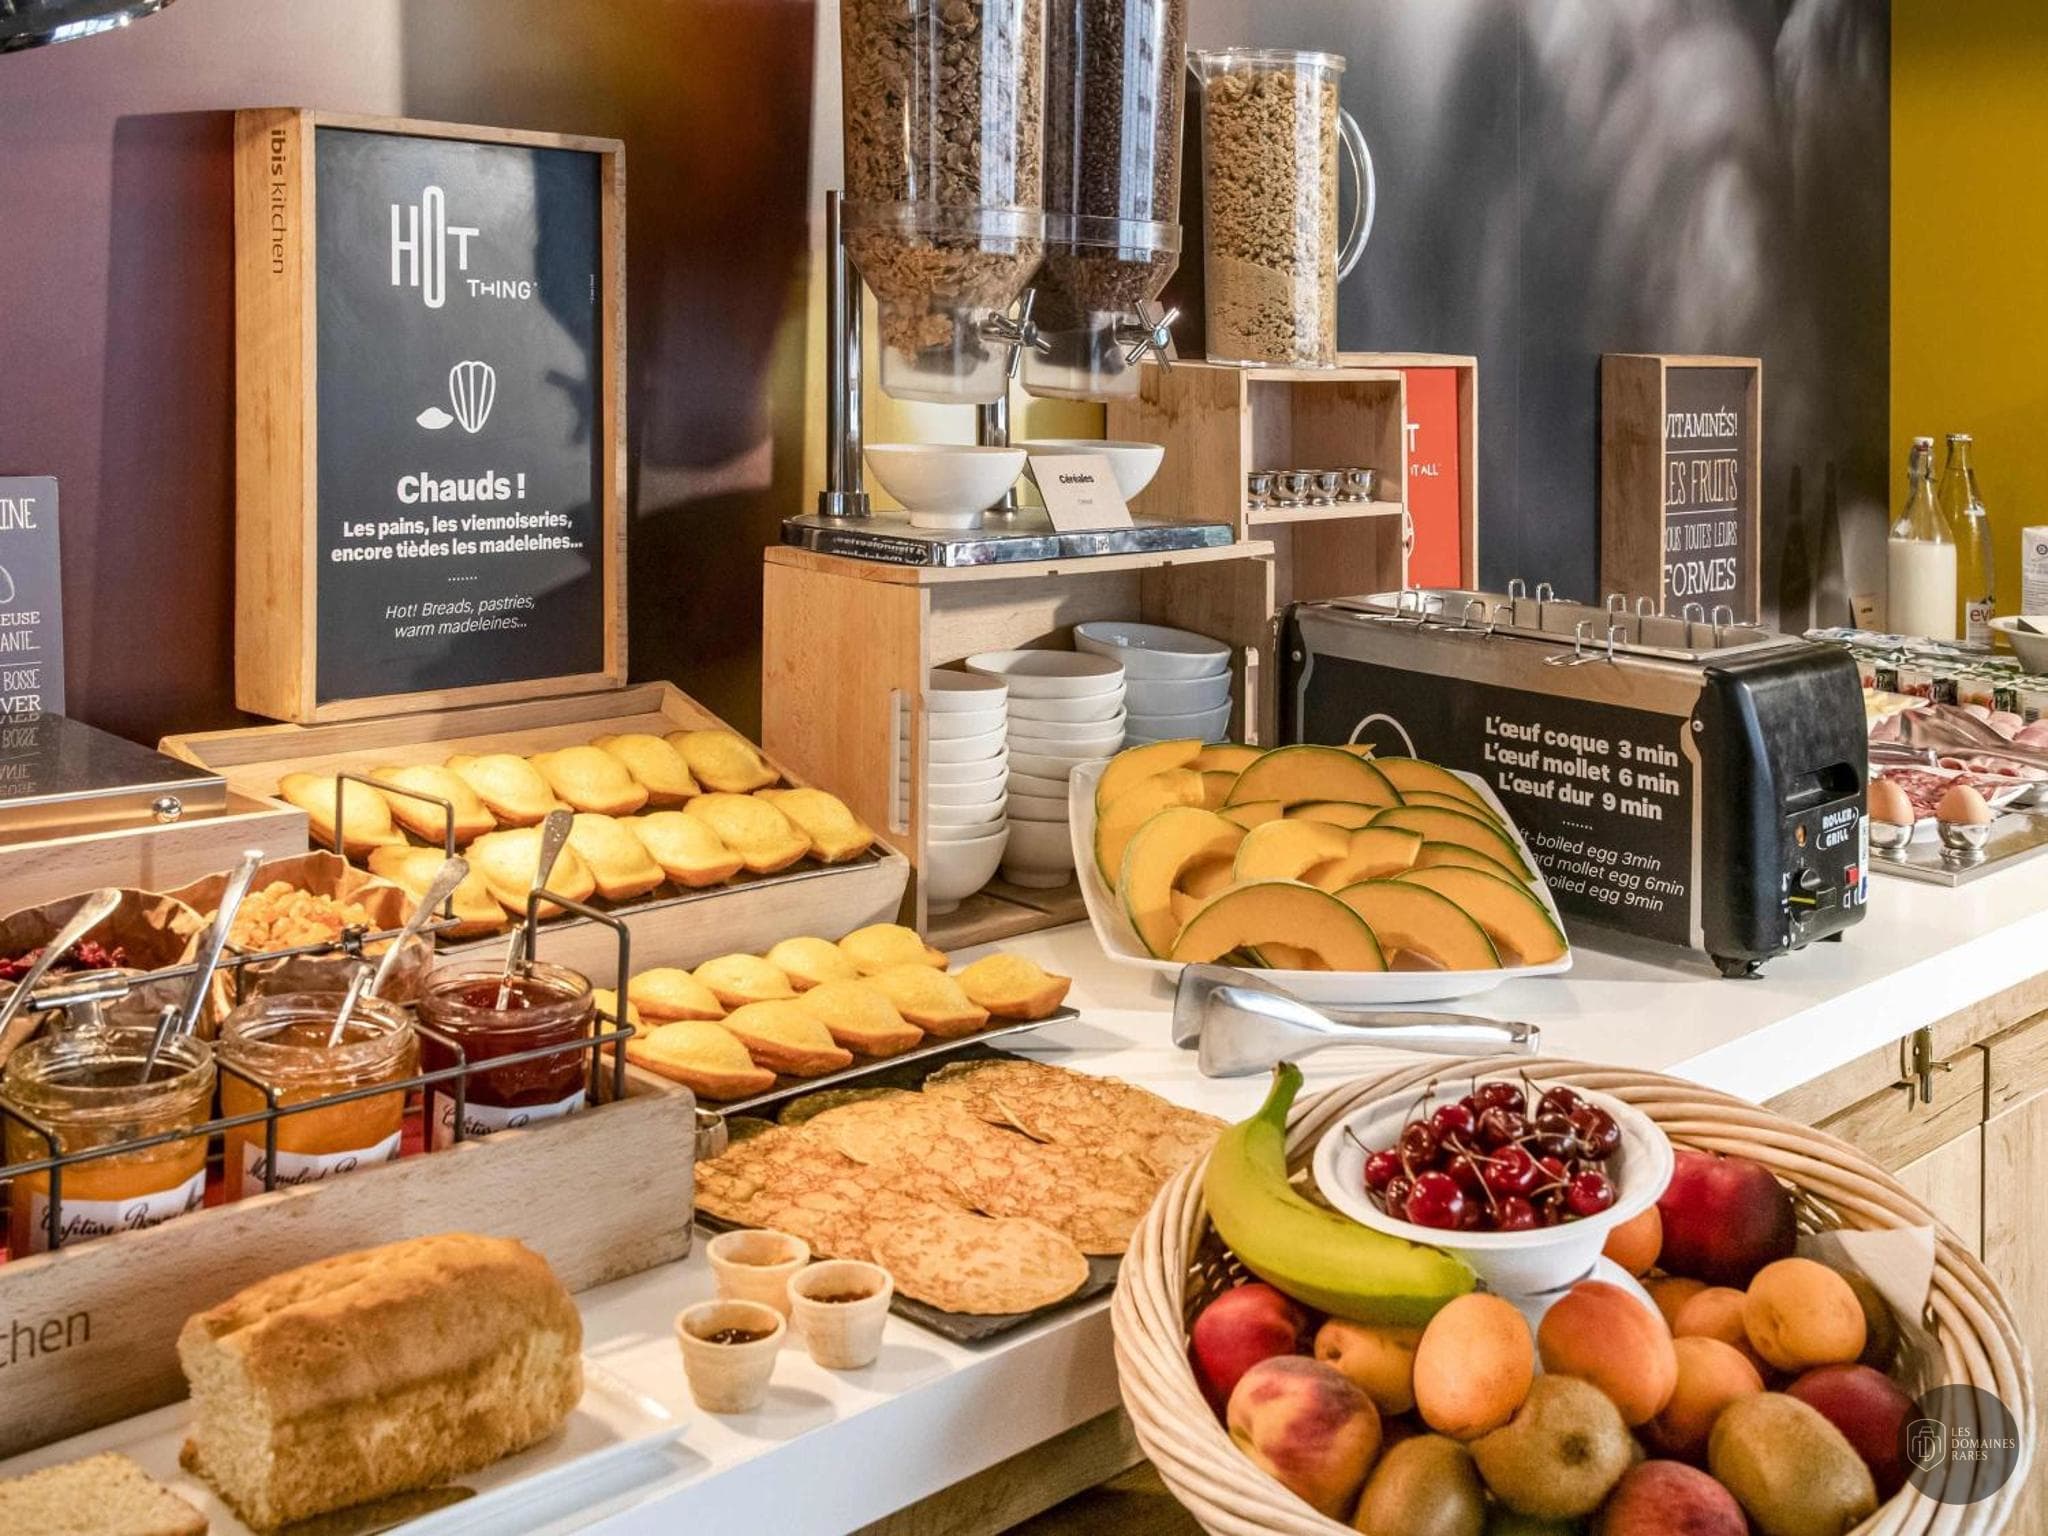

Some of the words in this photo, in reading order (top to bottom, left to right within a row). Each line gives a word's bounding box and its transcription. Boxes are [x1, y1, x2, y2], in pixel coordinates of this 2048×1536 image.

[271, 129, 286, 176] ibis
[271, 182, 287, 274] kitchen
[391, 186, 480, 309] HOT
[467, 279, 531, 300] THING
[1421, 464, 1439, 476] ALL
[1691, 458, 1738, 503] FRUITS
[397, 470, 511, 504] Chauds
[343, 521, 375, 538] Les
[378, 517, 430, 540] pains,
[432, 516, 458, 532] les
[461, 511, 573, 531] viennoiseries,
[1684, 523, 1711, 551] TOUTES
[331, 546, 393, 562] encore
[396, 539, 450, 559] tièdes
[452, 538, 477, 555] les
[480, 533, 583, 553] madeleines...
[385, 603, 417, 619] Hot!
[422, 598, 474, 617] Breads,
[478, 593, 535, 615] pastries,
[395, 624, 435, 639] warm
[438, 615, 527, 635] madeleines...
[3, 668, 40, 691] BOSSE
[1544, 729, 1609, 755] coque
[1618, 740, 1631, 758] 3
[1636, 744, 1679, 767] min
[1543, 756, 1610, 782] mollet
[1618, 769, 1632, 786] 6
[1637, 773, 1680, 796] min
[1559, 783, 1594, 806] dur
[1602, 792, 1616, 811] 9
[1621, 798, 1663, 821] min
[1587, 844, 1618, 865] egg
[1622, 852, 1661, 871] 3min
[1557, 859, 1606, 880] mollet
[1609, 869, 1640, 889] egg
[1645, 876, 1684, 897] 6min
[1589, 884, 1620, 905] egg
[1625, 892, 1664, 912] 9min
